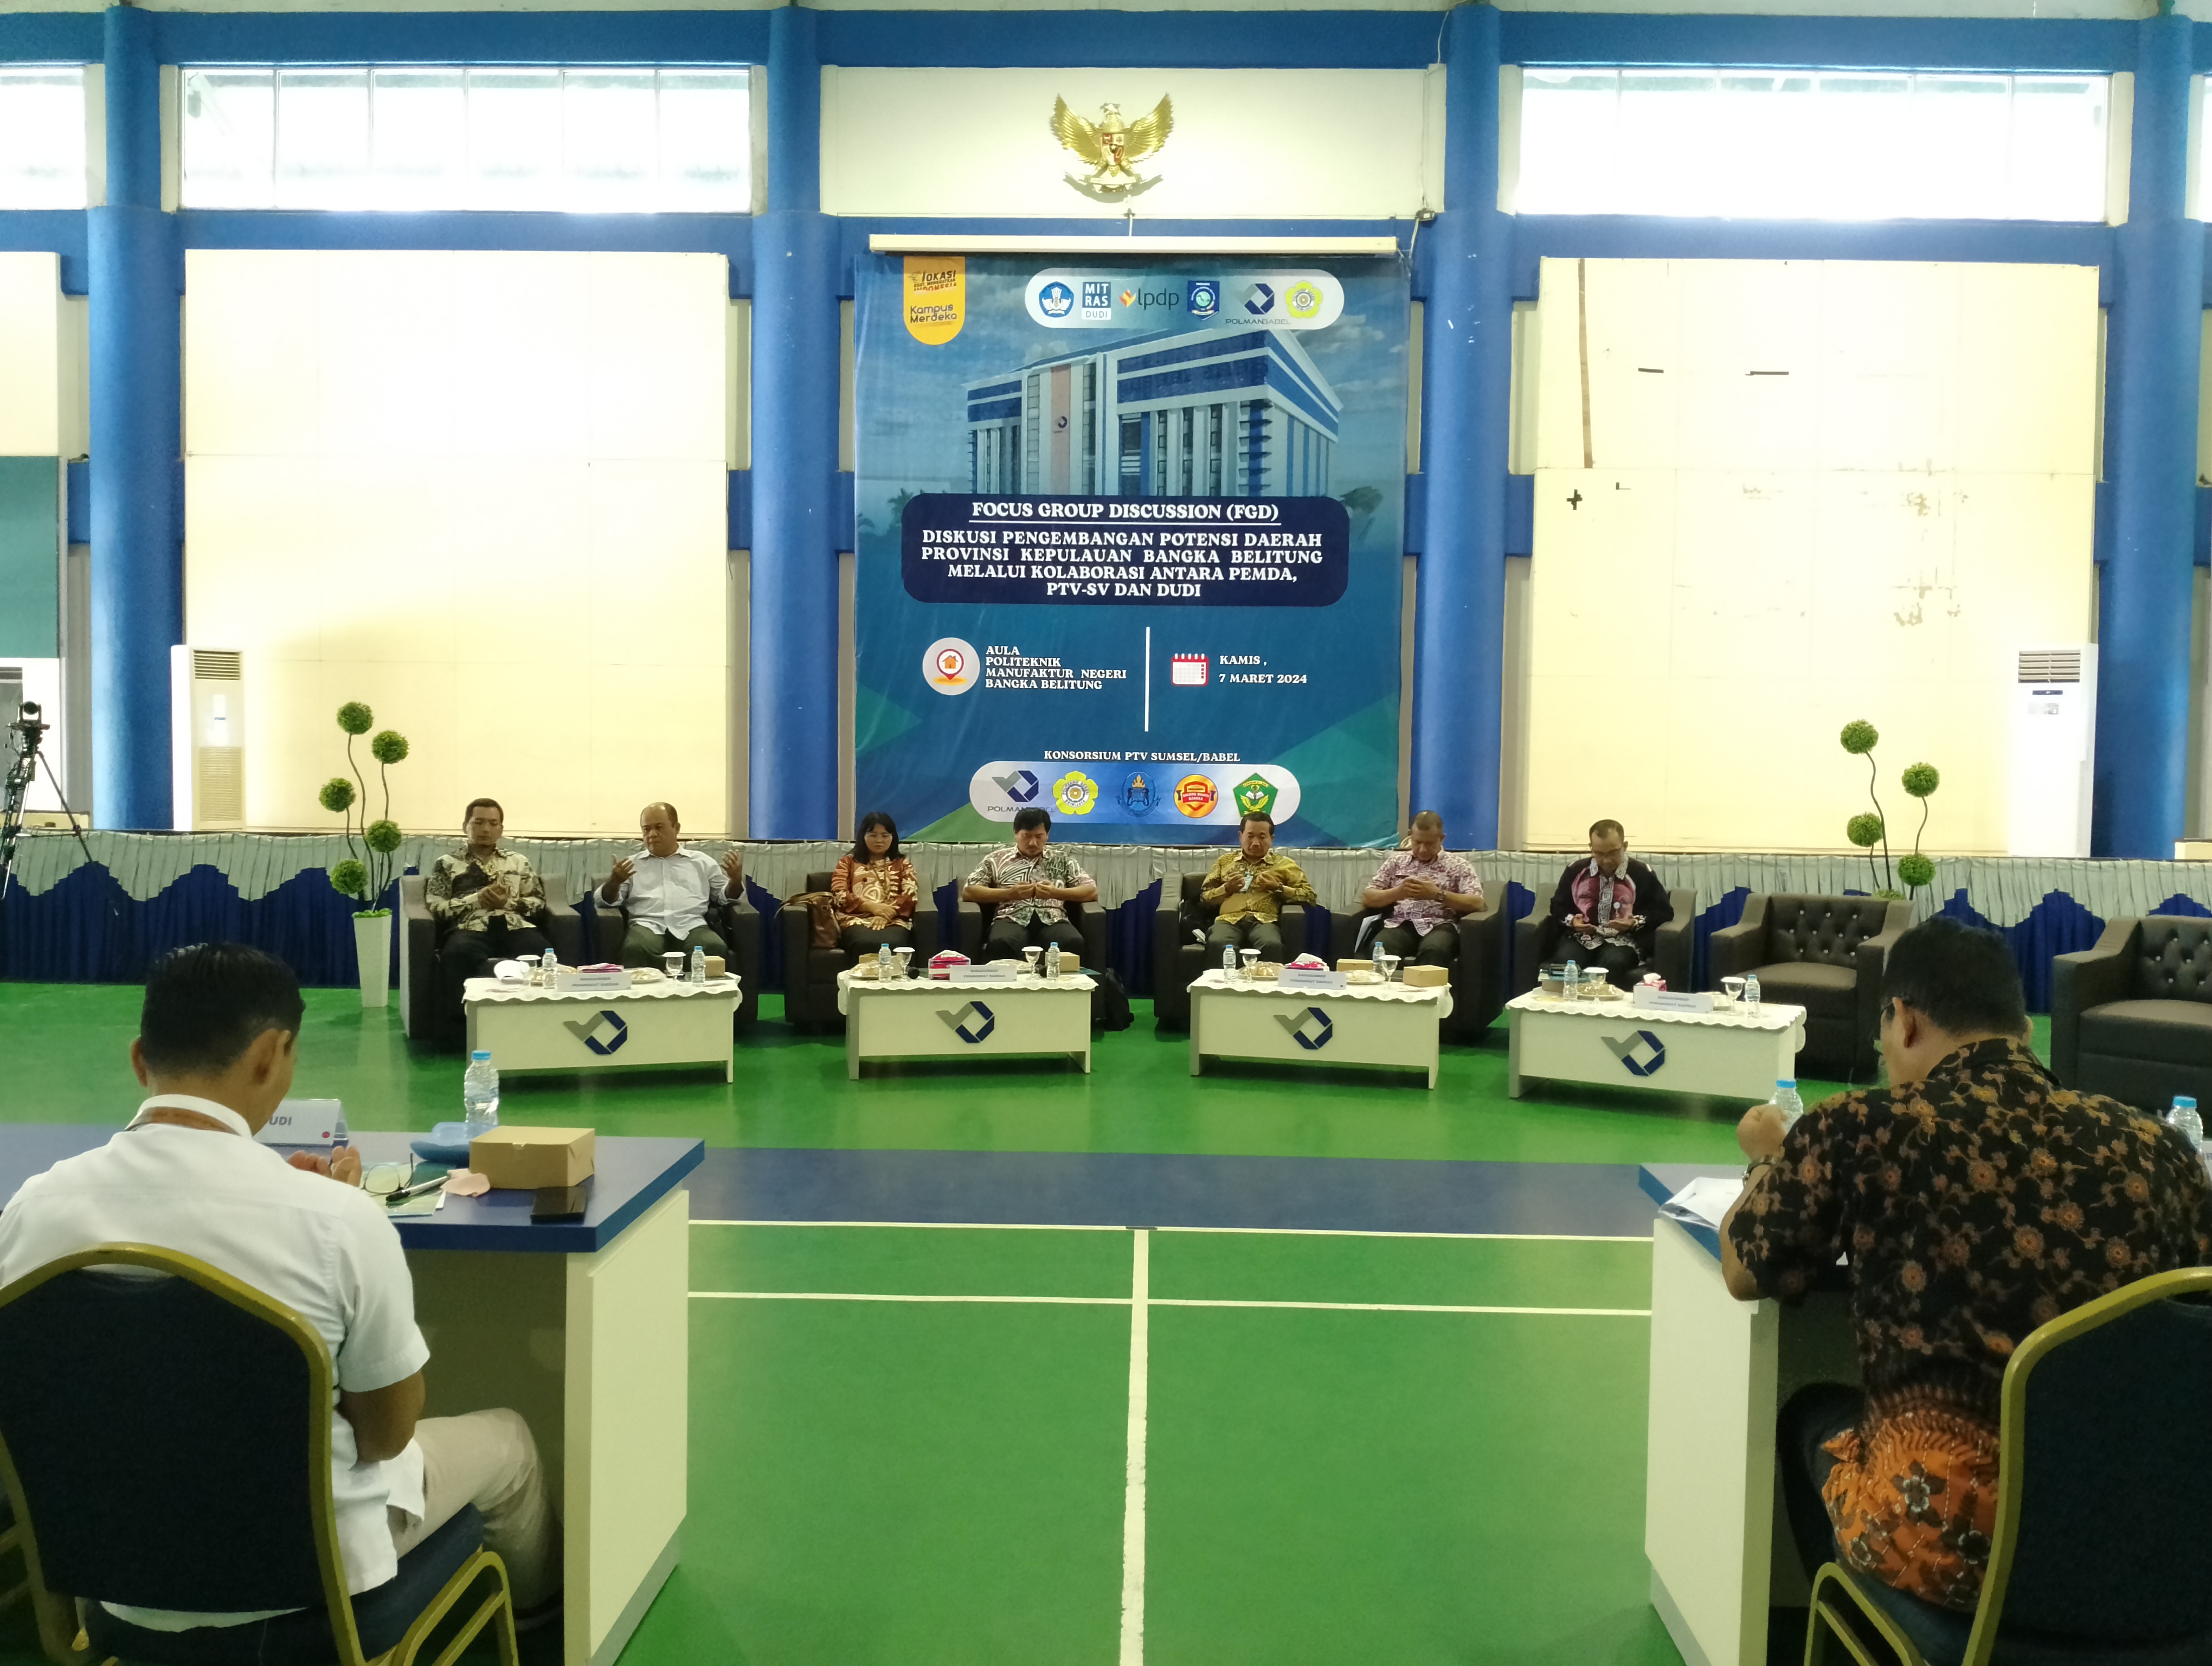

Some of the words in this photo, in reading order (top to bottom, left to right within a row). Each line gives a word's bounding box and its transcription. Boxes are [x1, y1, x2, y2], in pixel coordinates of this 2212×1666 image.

[1085, 284, 1108, 293] MIT
[1085, 296, 1108, 306] RAS
[1138, 288, 1179, 310] lpdp
[910, 304, 953, 315] Kampus
[910, 312, 957, 323] Merdeka
[972, 502, 1033, 517] FOCUS
[1038, 503, 1104, 518] GROUP
[1109, 504, 1221, 519] DISCUSSION
[1226, 503, 1279, 521] (FGD)
[922, 530, 996, 543] DISKUSI
[1002, 531, 1154, 546] PENGEMBANGAN
[1160, 533, 1238, 547] POTENSI
[1244, 533, 1322, 547] DAERAH
[921, 547, 1009, 561] PROVINSI
[1020, 548, 1132, 562] KEPULAUAN
[1143, 549, 1220, 563] BANGKA
[1231, 550, 1323, 563] BELITUNG
[947, 564, 1026, 578] MELALUI
[1031, 565, 1145, 580] KOLABORASI
[1149, 566, 1224, 580] ANTARA
[1229, 567, 1297, 582] PEMDA,
[1046, 582, 1110, 596] PTV-SV
[1114, 582, 1152, 597] DAN
[1156, 584, 1201, 597] DUDI
[986, 645, 1020, 656] AULA
[985, 656, 1062, 668] POLITEKNIK
[1219, 655, 1261, 665] KAMIS
[985, 668, 1074, 678] MANUFAKTUR
[1081, 669, 1127, 679] NEGERI
[1219, 674, 1226, 683] 7
[1229, 674, 1274, 683] MARET
[1277, 674, 1308, 683] 2024
[985, 678, 1038, 689] BANGKA
[1041, 680, 1103, 690] BELITUNG
[1044, 751, 1121, 760] KONSORSIUM
[1124, 752, 1148, 760] PTV
[1150, 752, 1240, 763] SUMSEL/BABEL
